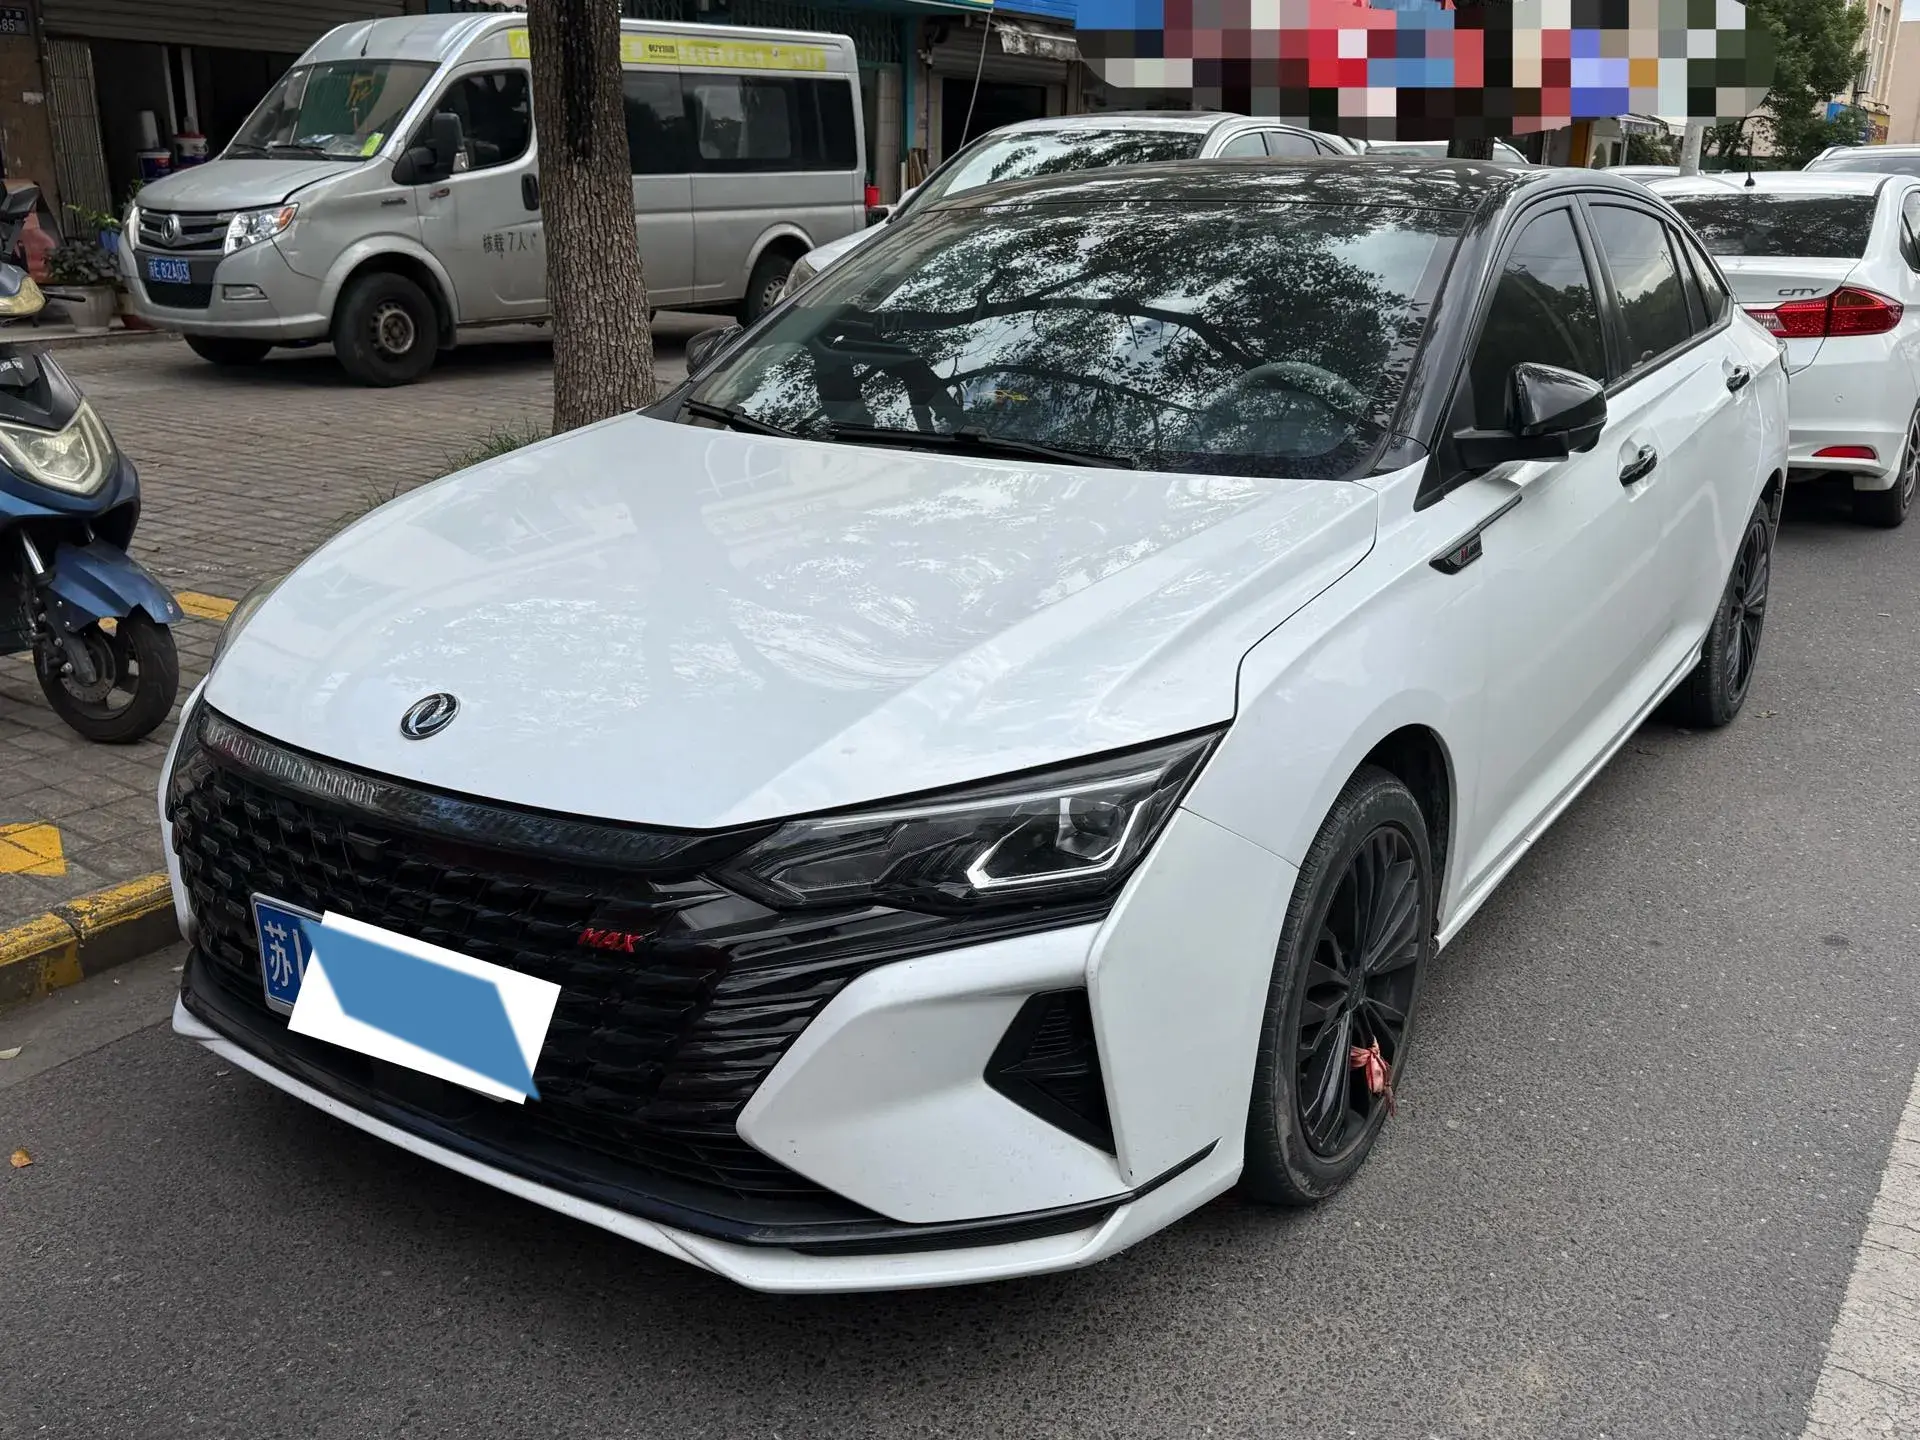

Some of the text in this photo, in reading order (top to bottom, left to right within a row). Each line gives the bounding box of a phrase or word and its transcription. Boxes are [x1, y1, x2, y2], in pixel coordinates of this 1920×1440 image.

[1778, 287, 1823, 296] CITY
[577, 927, 644, 953] MAX
[263, 919, 305, 988] 苏
